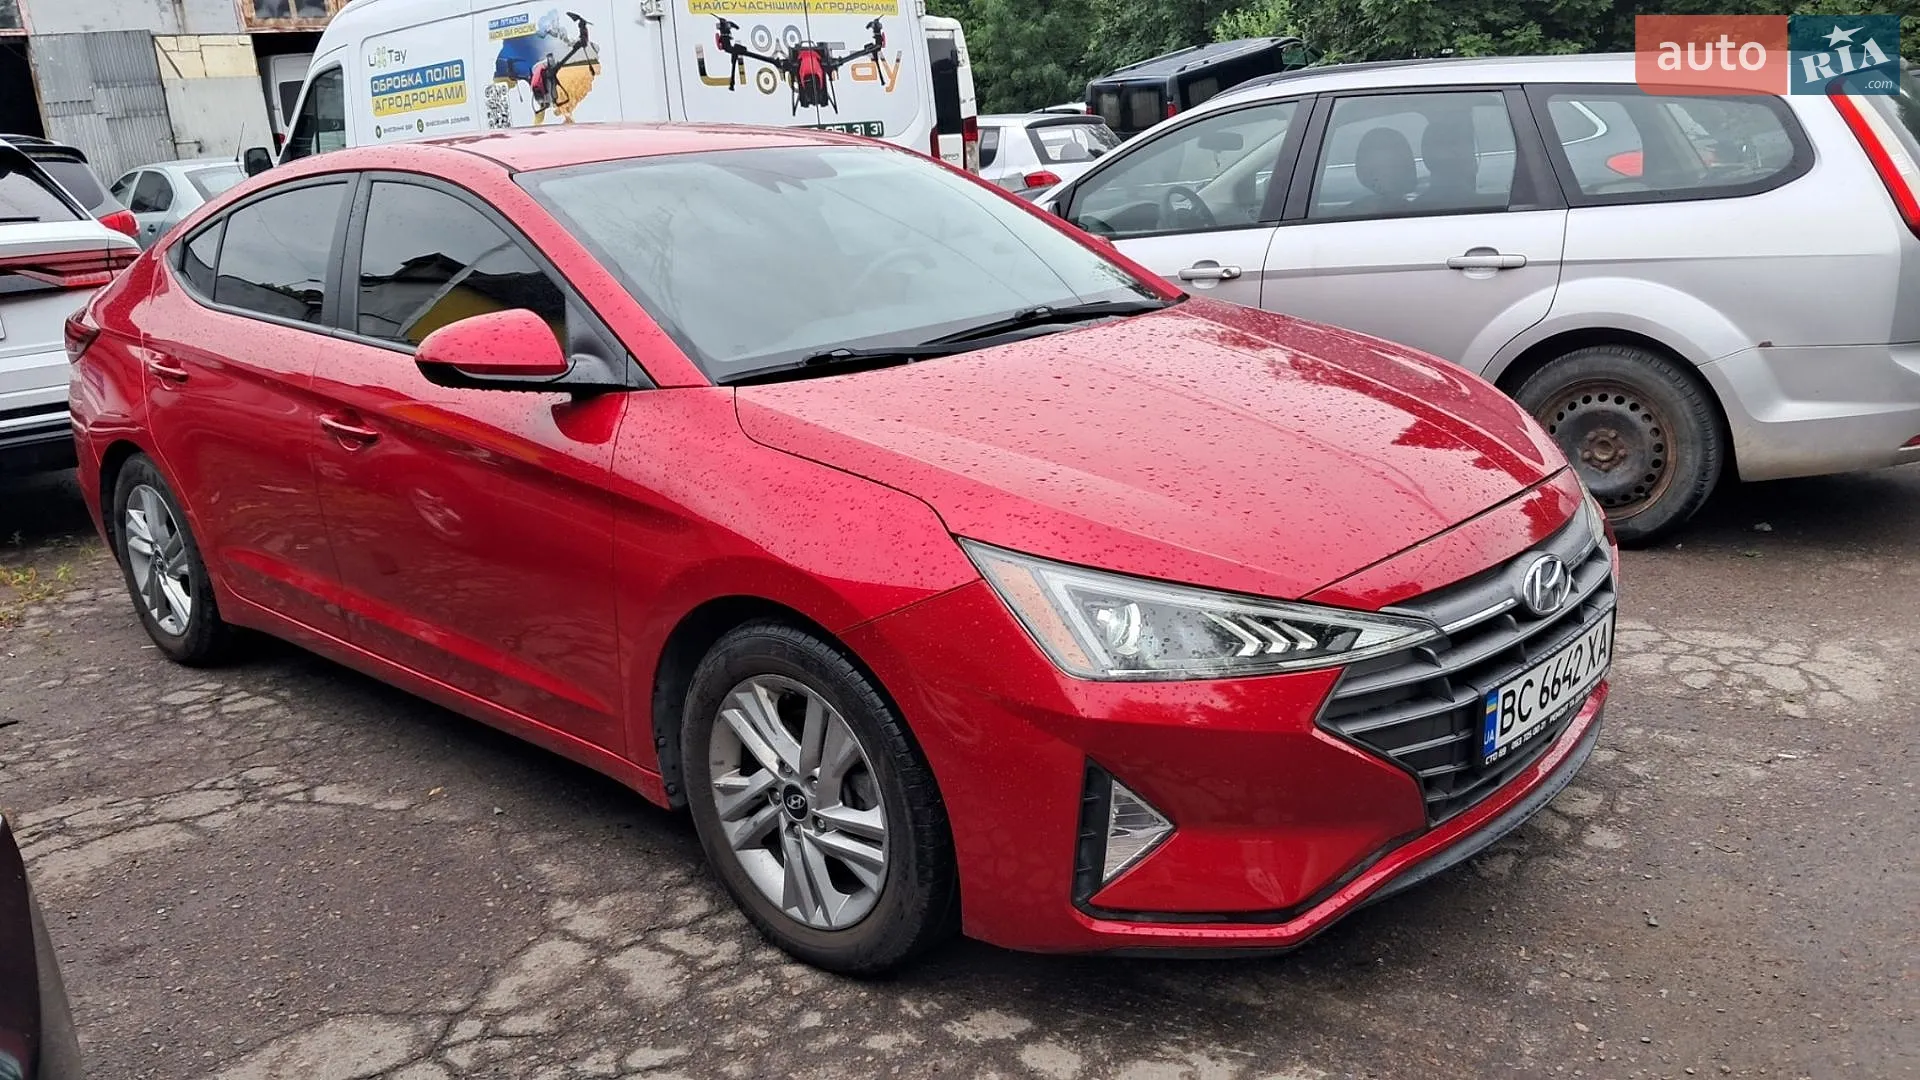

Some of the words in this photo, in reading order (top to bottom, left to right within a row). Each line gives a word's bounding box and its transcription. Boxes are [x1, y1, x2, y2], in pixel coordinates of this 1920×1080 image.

[693, 0, 811, 11] НАЙСУЧАСНІШИМИ
[815, 2, 895, 12] АГРОДРОНАМИ
[372, 71, 423, 93] ОБРОБКА
[425, 63, 462, 83] ПОЛІВ
[374, 85, 464, 111] АГРОДРОНАМИ
[852, 124, 866, 136] 31
[870, 123, 882, 135] 31
[1500, 678, 1534, 737] BC
[1539, 643, 1584, 710] 6642
[1585, 622, 1607, 676] XA
[1484, 729, 1495, 746] UA
